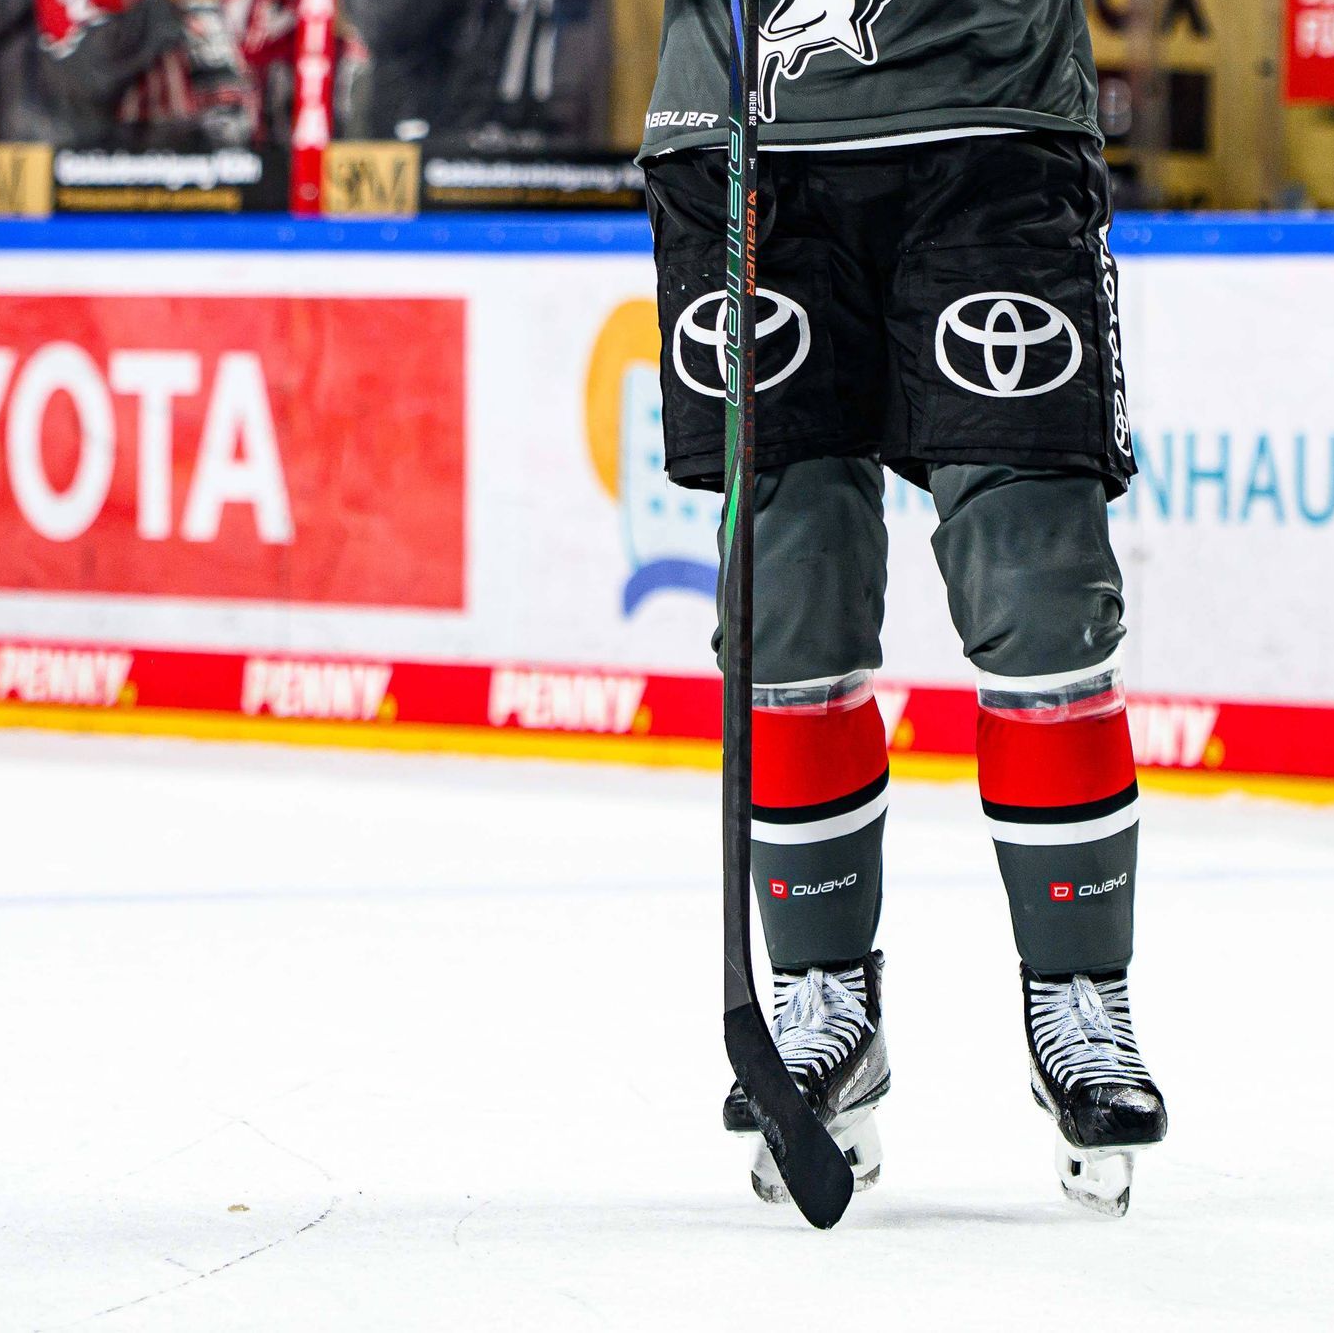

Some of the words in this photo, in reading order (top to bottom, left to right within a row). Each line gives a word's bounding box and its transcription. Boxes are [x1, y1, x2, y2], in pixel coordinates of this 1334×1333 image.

[748, 90, 759, 114] NOEBI
[649, 111, 719, 129] BAUER
[748, 115, 759, 127] 92
[745, 206, 757, 298] BAUER
[1097, 224, 1123, 383] TOYOTA
